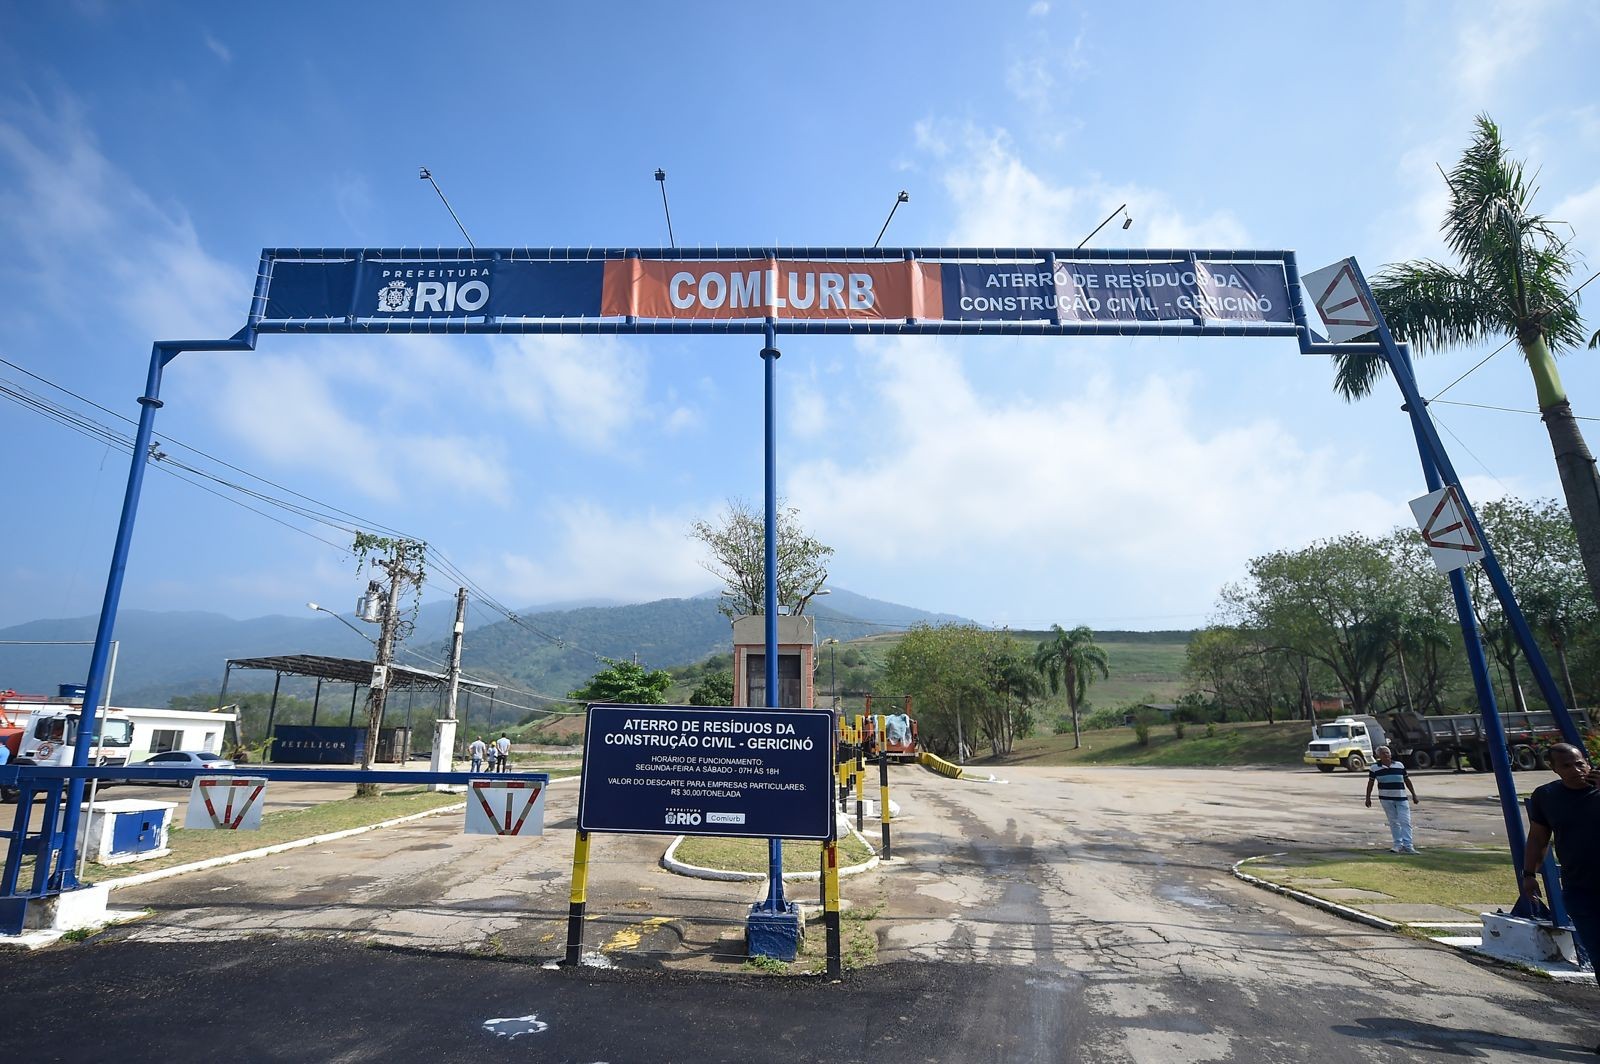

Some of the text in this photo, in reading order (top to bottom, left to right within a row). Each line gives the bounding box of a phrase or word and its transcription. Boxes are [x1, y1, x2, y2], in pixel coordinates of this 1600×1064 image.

[382, 268, 491, 278] PREFEITURA
[986, 269, 1242, 288] ATERRO DE RESÍDUOS DA
[414, 280, 490, 313] RIO
[669, 270, 876, 310] COMLURB
[959, 293, 1101, 314] CONSTRUÇÃO
[1107, 296, 1158, 313] CIVIL
[1176, 294, 1272, 313] GERICINÓ
[623, 719, 796, 735] ATERRO DE RESÍDUOS DA
[604, 733, 699, 749] CONSTRUÇÃO
[702, 736, 736, 749] CIVIL
[747, 736, 814, 751] GERICINÓ
[651, 755, 686, 763] HORÁRIO
[698, 757, 764, 766] FUNCIONAMENTO:
[635, 763, 694, 772] SEGUNDA-FEIRA
[702, 765, 733, 774] SÁBADO
[633, 778, 645, 786] DO
[646, 779, 685, 787] DESCARTE
[686, 780, 706, 788] PARA
[707, 781, 748, 789] EMPRESAS
[749, 782, 807, 791] PARTICULARES:
[671, 788, 741, 798] R$ 30,00/TONELADA
[676, 812, 702, 826] RIO
